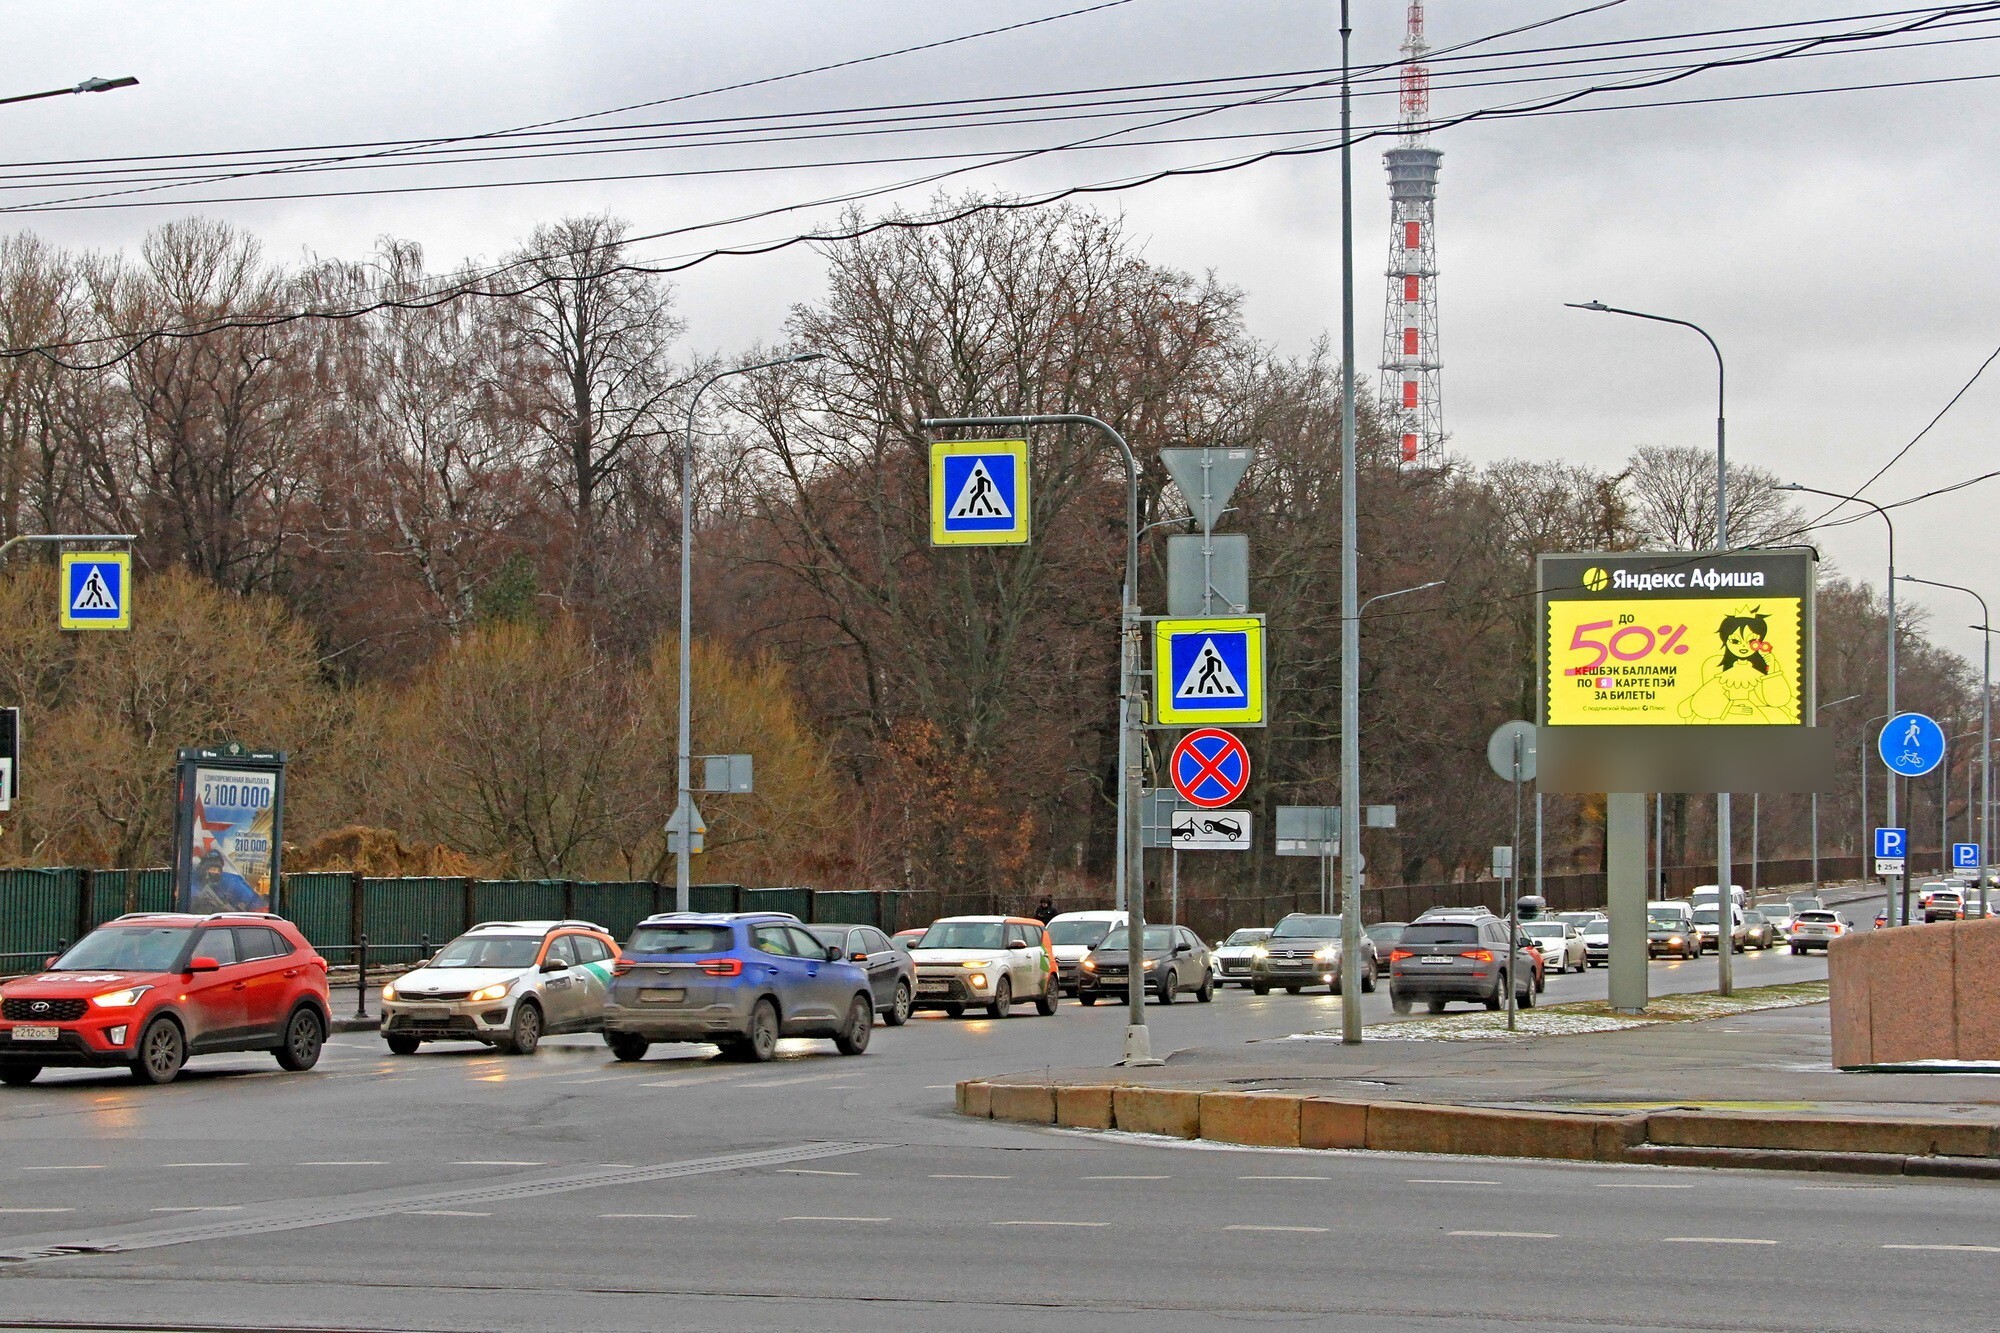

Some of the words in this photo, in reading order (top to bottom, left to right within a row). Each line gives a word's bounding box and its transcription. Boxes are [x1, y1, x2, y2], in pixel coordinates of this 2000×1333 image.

[1613, 570, 1685, 591] Яндекс
[1690, 568, 1764, 591] Афиша
[1618, 614, 1635, 624] ДО
[1564, 620, 1689, 676] 50%
[1575, 666, 1620, 675] КЕШБЭК
[1622, 666, 1677, 675] БАЛЛАМИ
[1577, 678, 1592, 687] ПО
[1615, 678, 1650, 688] КАРТЕ
[1652, 676, 1675, 687] ПЭЙ
[1594, 690, 1608, 700] ЗА
[1610, 690, 1656, 700] БИЛЕТЫ
[204, 783, 211, 805] 2
[215, 784, 237, 806] 100
[241, 785, 270, 808] 000
[1884, 832, 1901, 854] P
[1960, 847, 1974, 865] P
